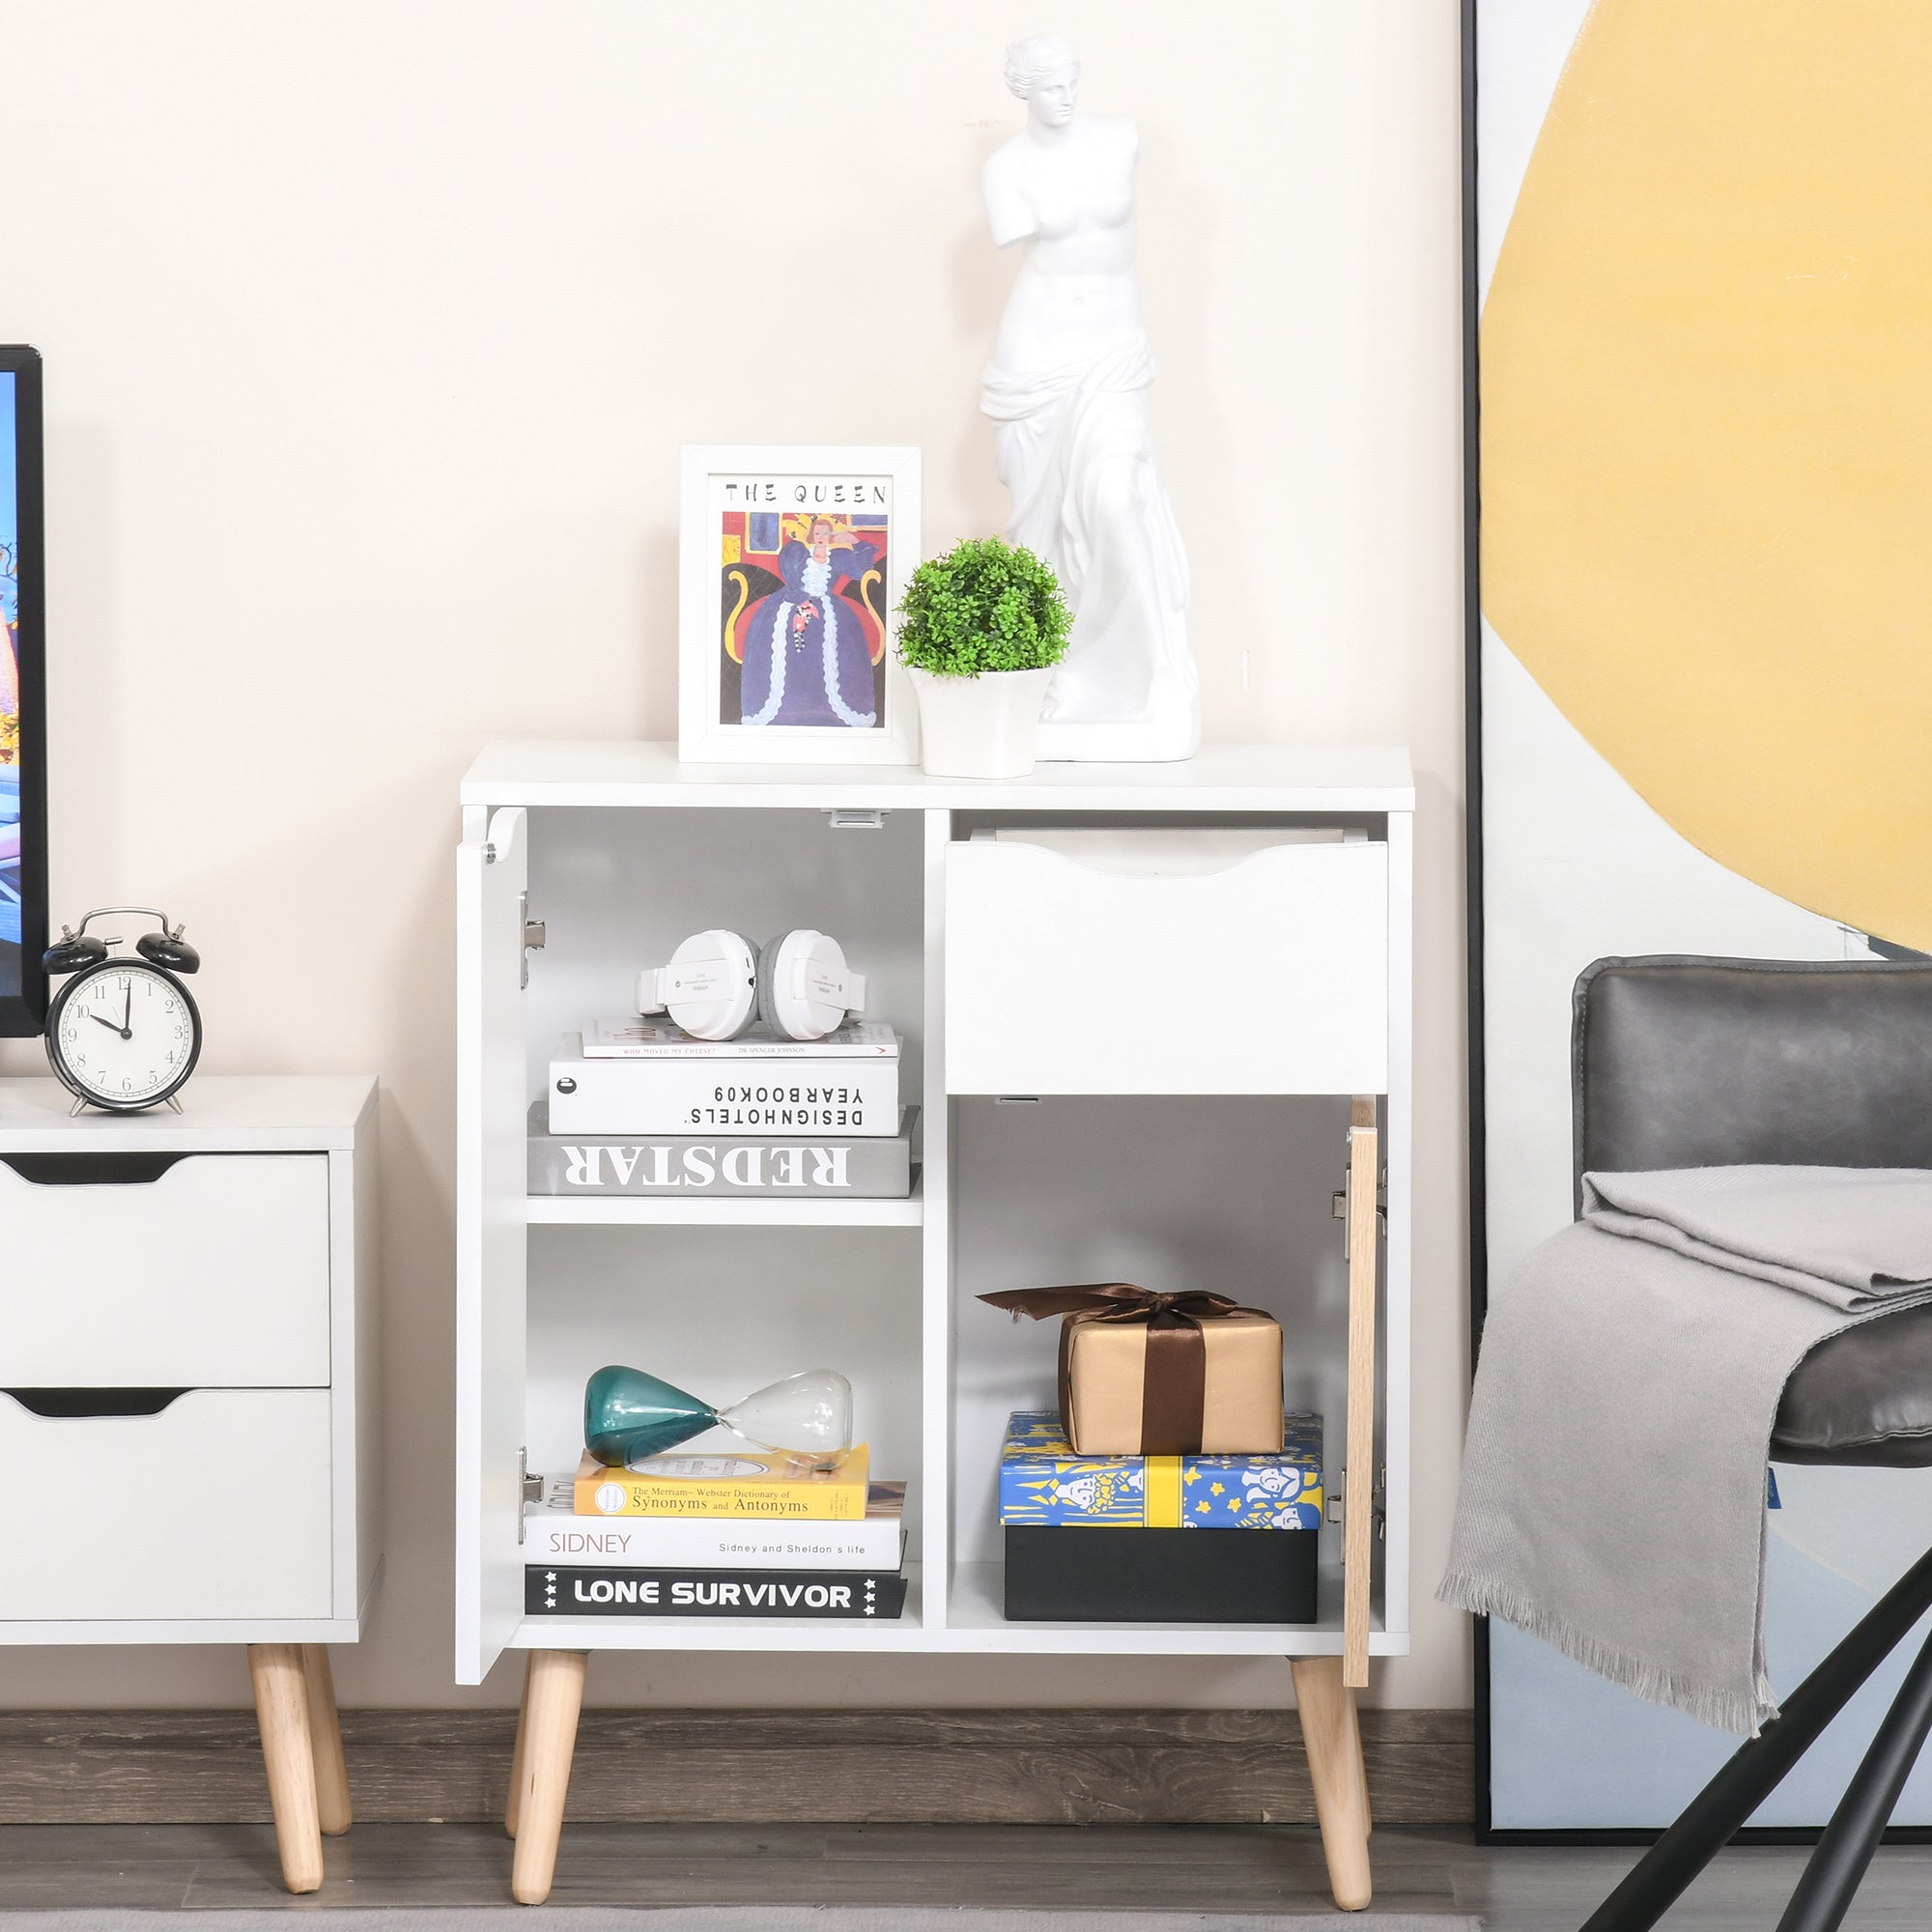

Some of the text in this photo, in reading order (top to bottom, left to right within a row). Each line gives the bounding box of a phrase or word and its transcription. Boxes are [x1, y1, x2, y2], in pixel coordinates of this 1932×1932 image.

[725, 483, 886, 503] THE QUEEN
[117, 977, 131, 990] 12
[146, 982, 153, 997] 1
[94, 985, 106, 1000] 11
[76, 1005, 90, 1019] 10
[164, 1000, 175, 1013] 2
[68, 1029, 77, 1042] 9
[174, 1025, 184, 1039] 3
[76, 1053, 87, 1067] 8
[164, 1050, 175, 1065] 4
[98, 1070, 107, 1085] 7
[122, 1077, 131, 1092] 6
[148, 1070, 158, 1085] 5
[715, 1087, 864, 1103] YEARBOOK09
[560, 1146, 852, 1187] REDSTAR
[696, 1489, 730, 1497] Webster
[733, 1490, 778, 1499] Dictionary
[633, 1494, 707, 1512] Synonyms
[734, 1499, 809, 1515] Antonyms
[550, 1533, 632, 1553] SIDNEY
[719, 1544, 756, 1554] Sidney
[762, 1545, 781, 1553] and
[786, 1545, 832, 1553] Sheldon
[847, 1546, 866, 1554] life
[574, 1579, 851, 1608] LONE SURVIVOR
